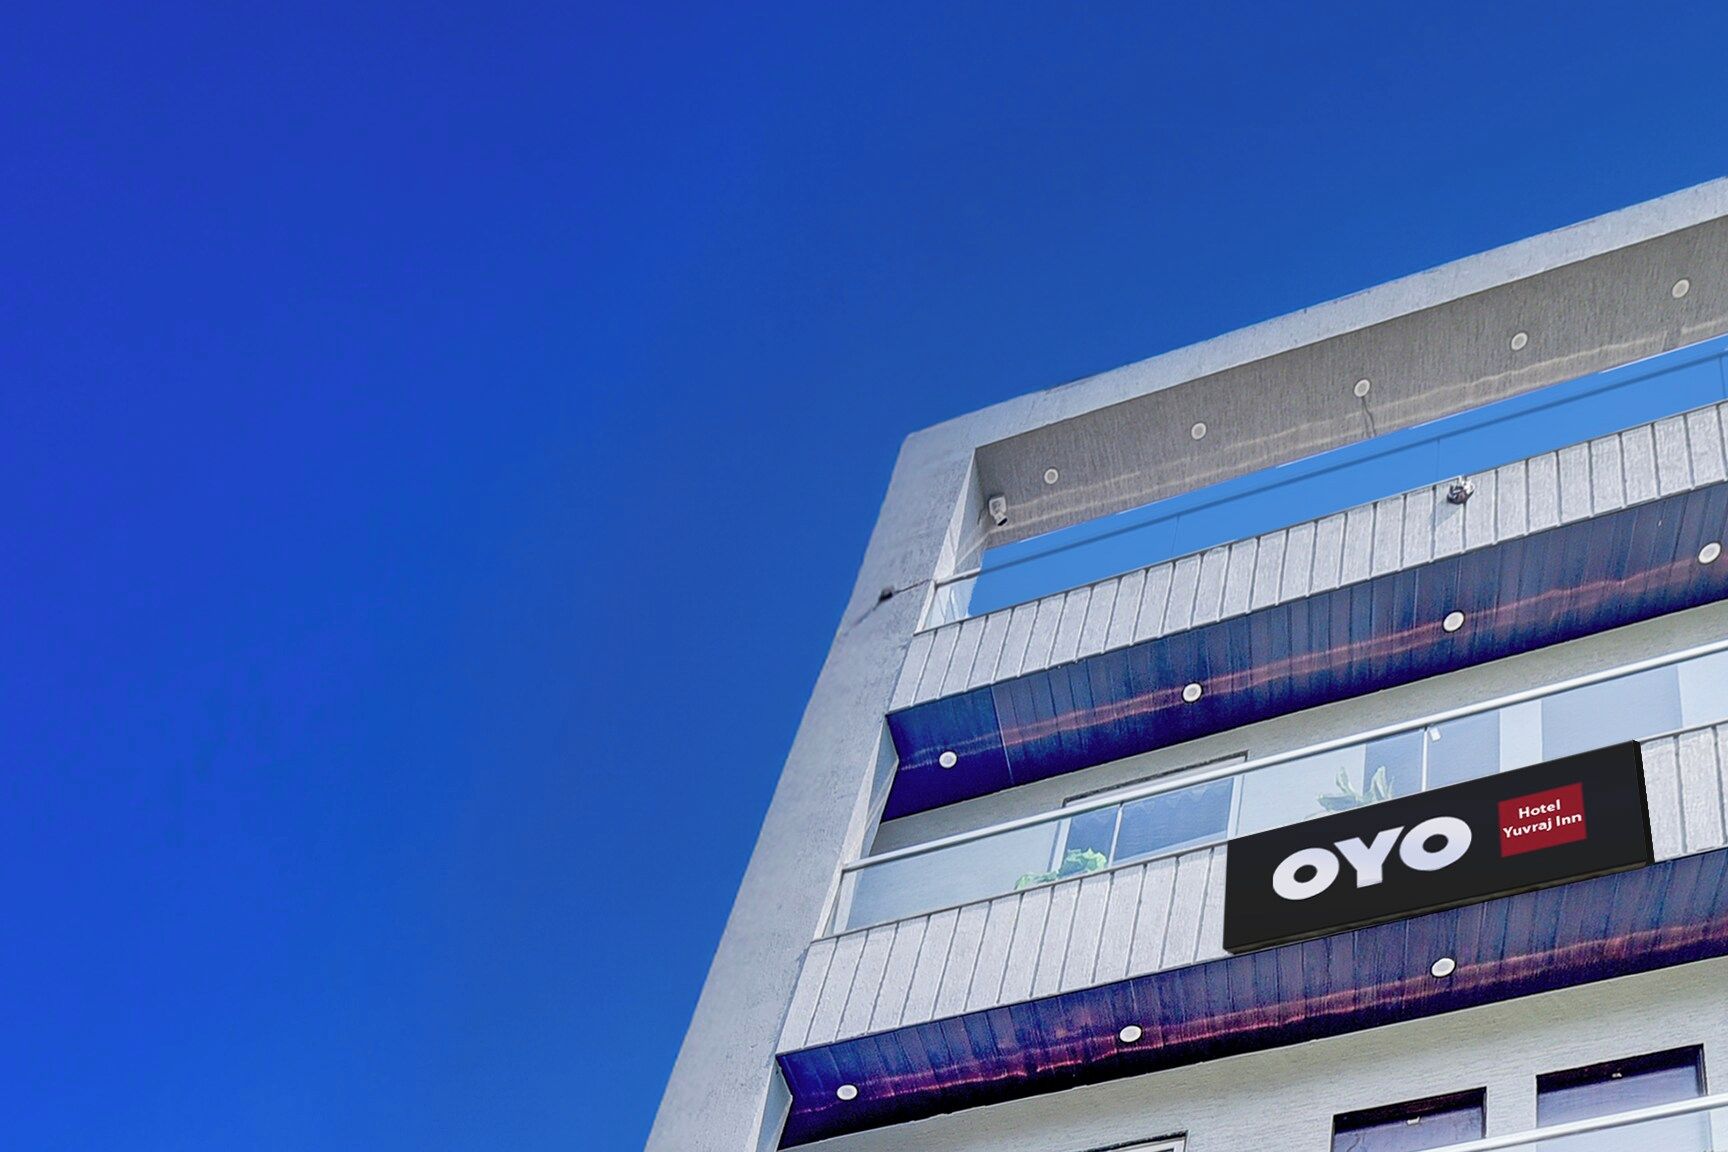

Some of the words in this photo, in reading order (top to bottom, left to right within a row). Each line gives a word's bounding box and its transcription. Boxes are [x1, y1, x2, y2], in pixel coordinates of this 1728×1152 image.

[1518, 799, 1561, 819] Hotel
[1502, 817, 1552, 838] Yuvraj
[1555, 813, 1582, 827] Inn
[1273, 816, 1472, 900] OYO
